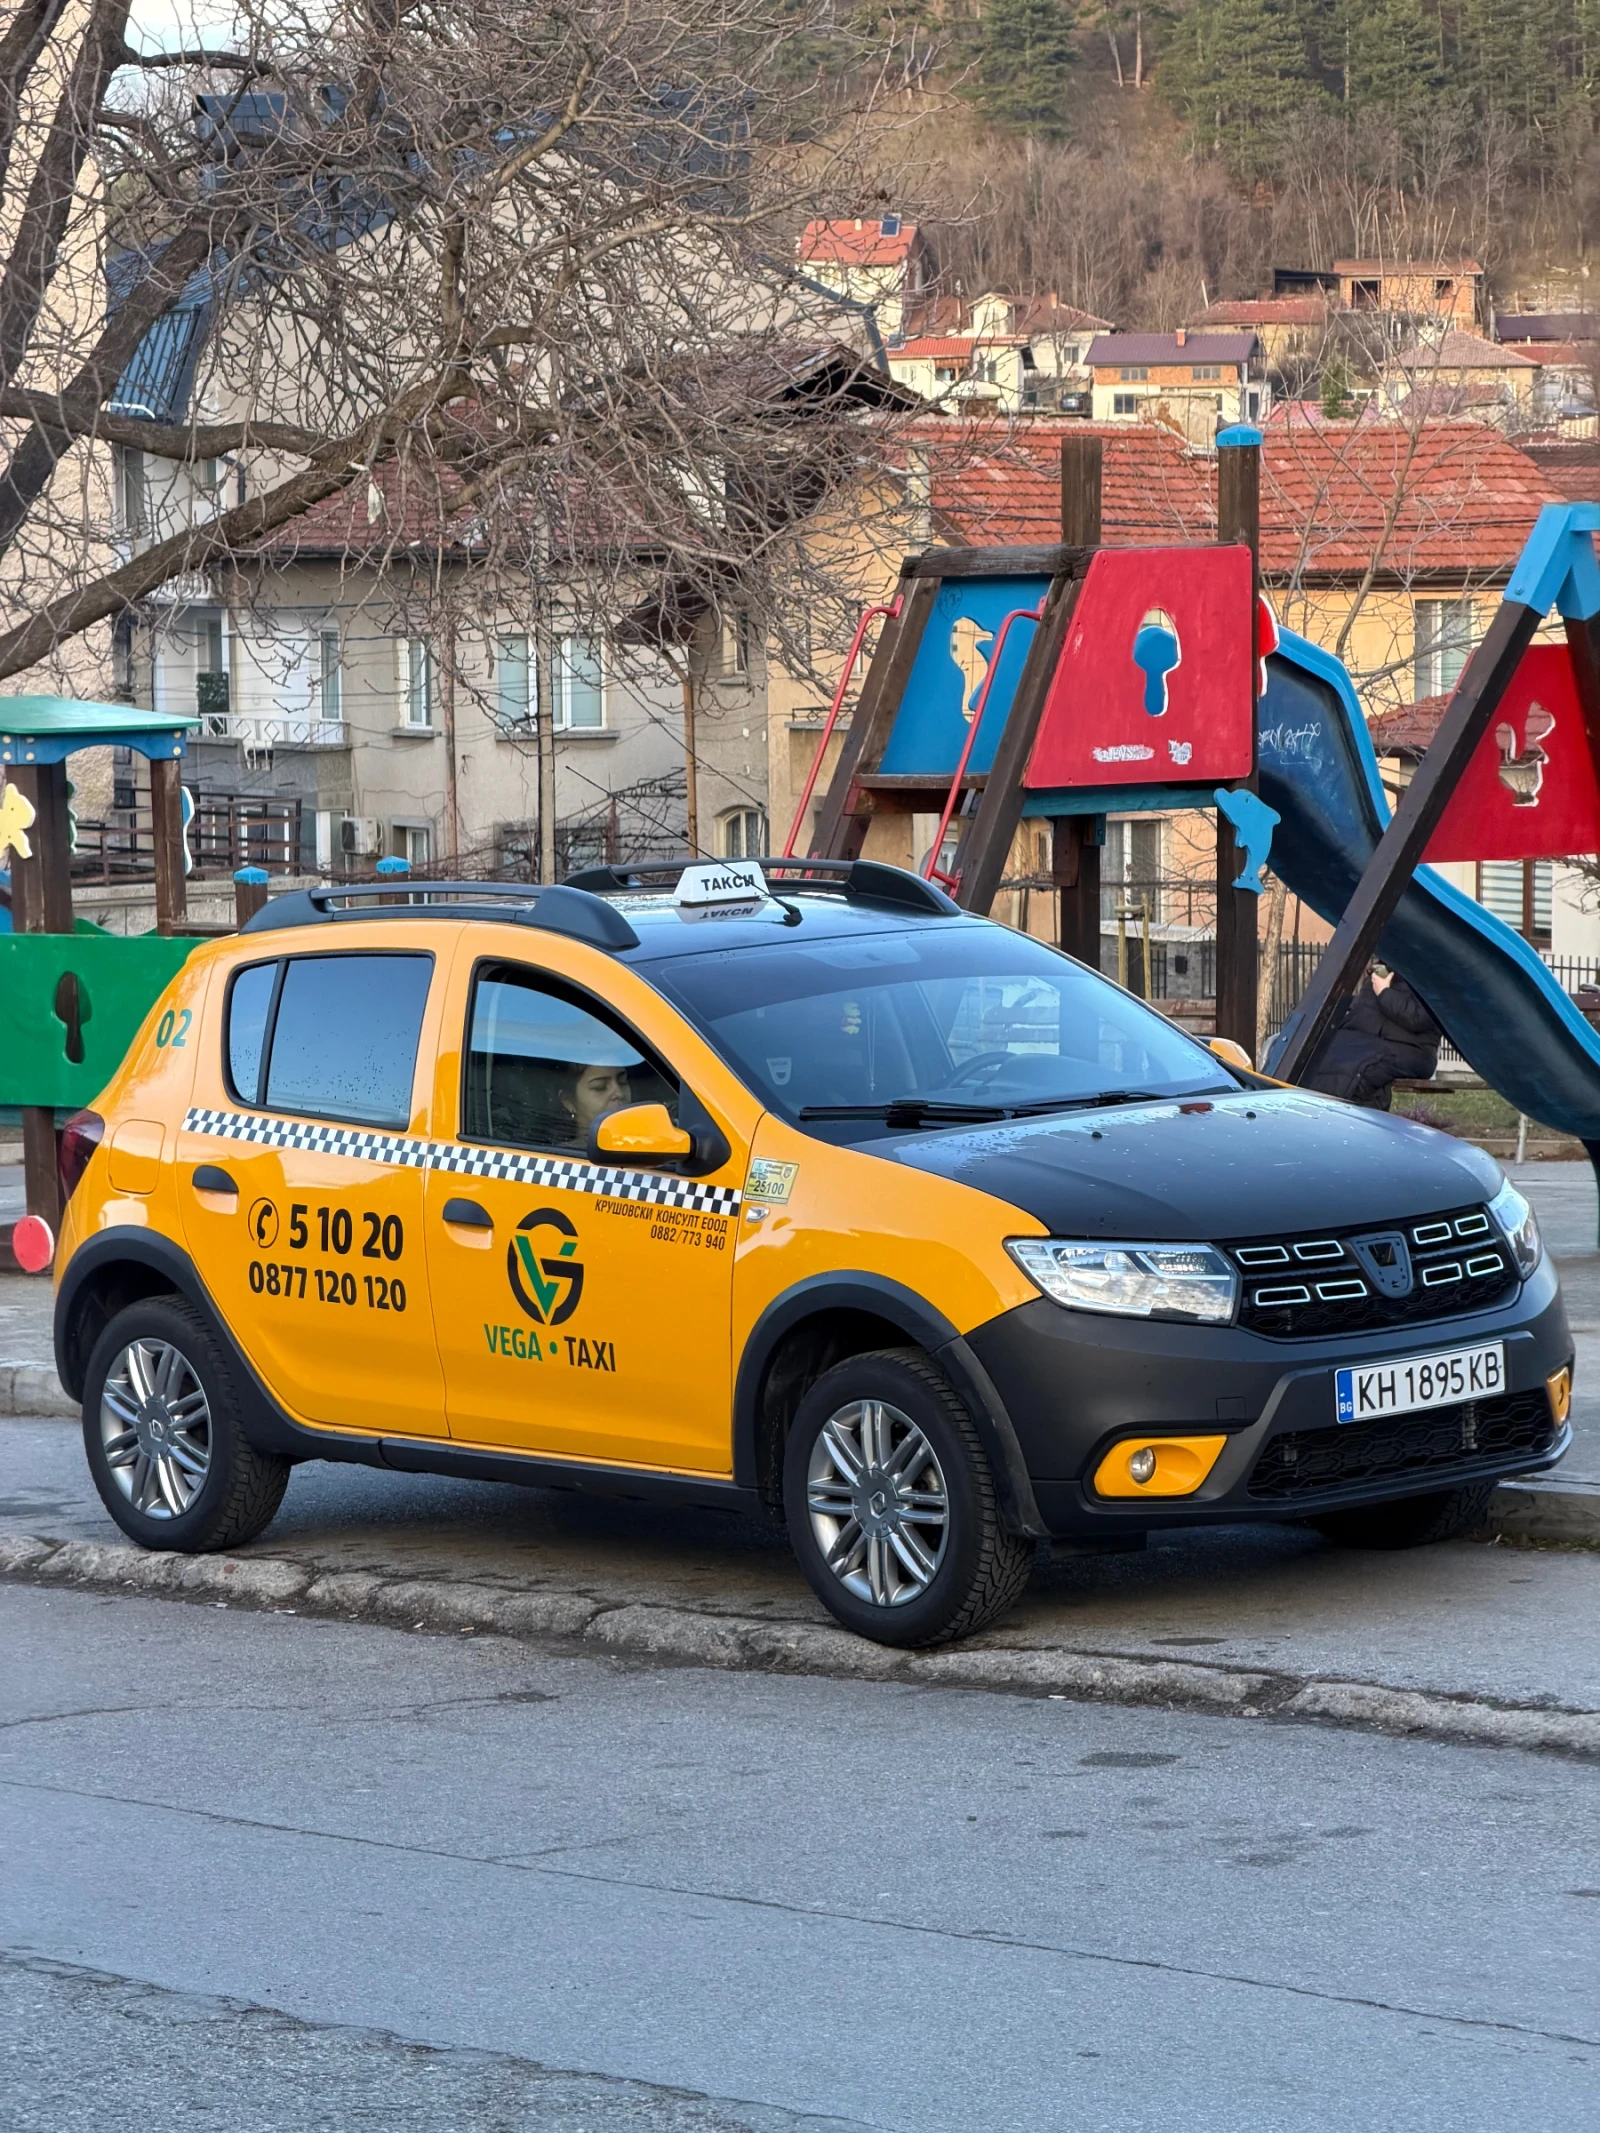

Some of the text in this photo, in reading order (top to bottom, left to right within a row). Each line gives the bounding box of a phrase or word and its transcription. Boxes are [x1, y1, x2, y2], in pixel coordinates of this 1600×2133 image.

[701, 874, 756, 891] ТАКСИ
[156, 1009, 193, 1048] 02
[753, 1180, 785, 1195] 25100
[290, 1203, 404, 1261] 5 10 20
[595, 1199, 728, 1234] КРУШОВСКИ КОНСУЛТ ЕООД
[650, 1225, 726, 1251] 0882/773 940
[249, 1261, 407, 1312] 0877 120 120
[484, 1323, 616, 1372] VEGA TAXI
[1405, 1361, 1464, 1404] 1895
[1469, 1351, 1500, 1392] KB
[1339, 1402, 1353, 1414] BG
